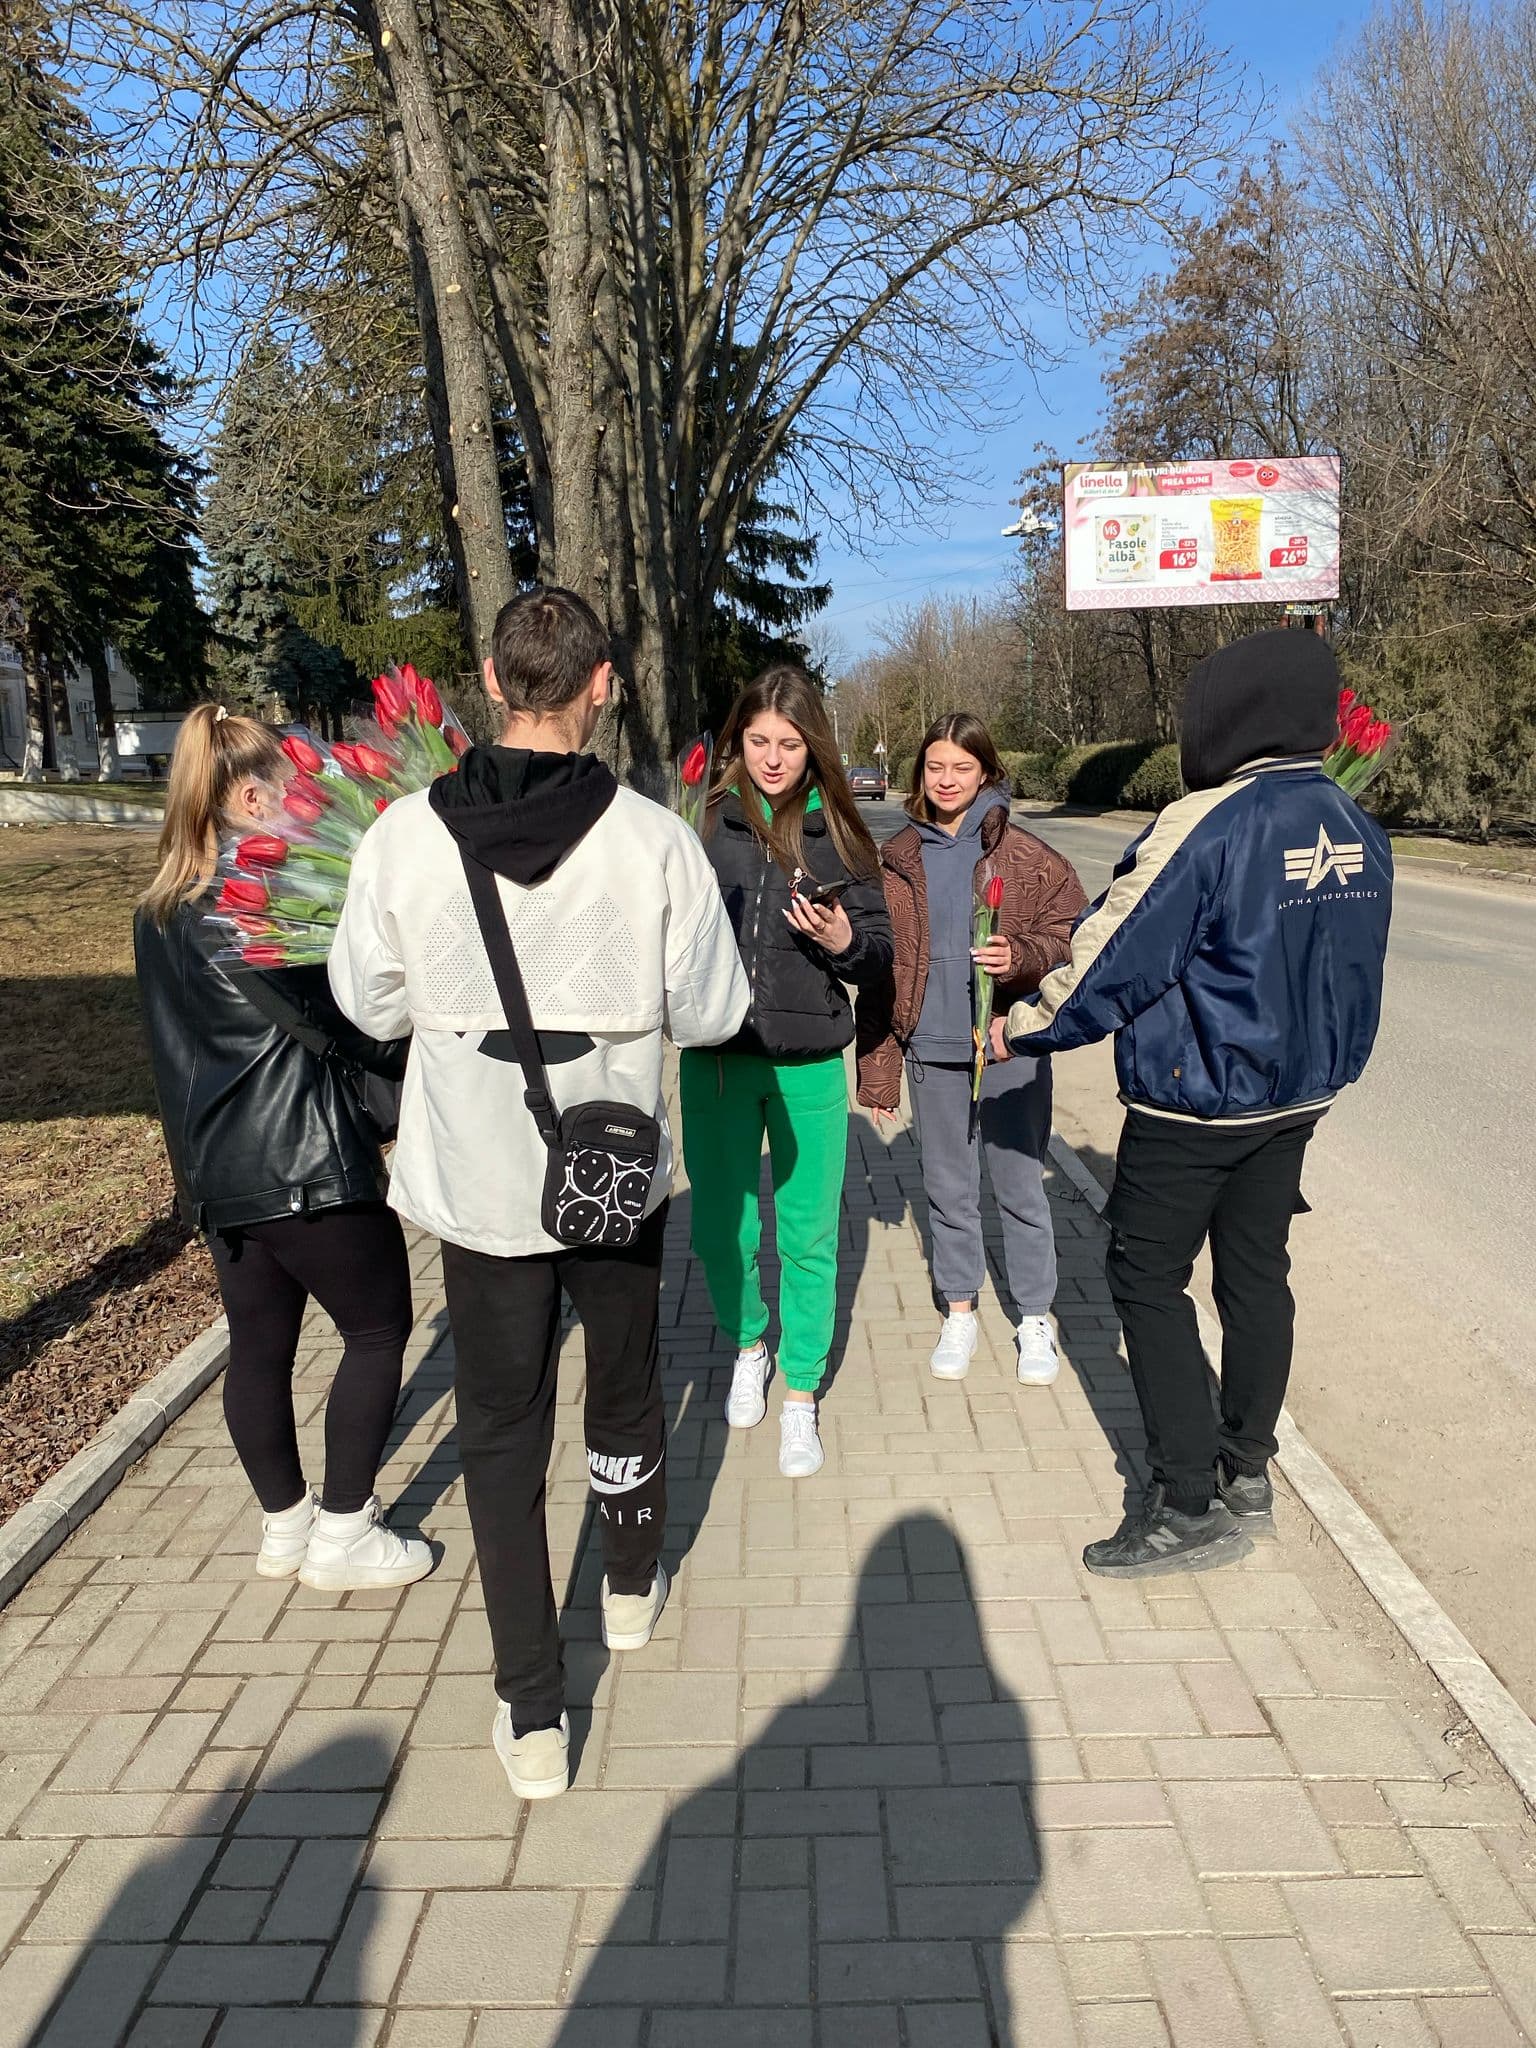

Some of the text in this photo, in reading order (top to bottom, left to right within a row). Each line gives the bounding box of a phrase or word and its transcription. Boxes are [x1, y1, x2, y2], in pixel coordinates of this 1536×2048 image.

[1161, 475, 1210, 487] PREA BUNE
[1108, 537, 1147, 549] Fasole
[1108, 550, 1136, 562] albă
[1278, 891, 1378, 910] ALPHA INDUSTRIES
[600, 1501, 653, 1525] AIR
